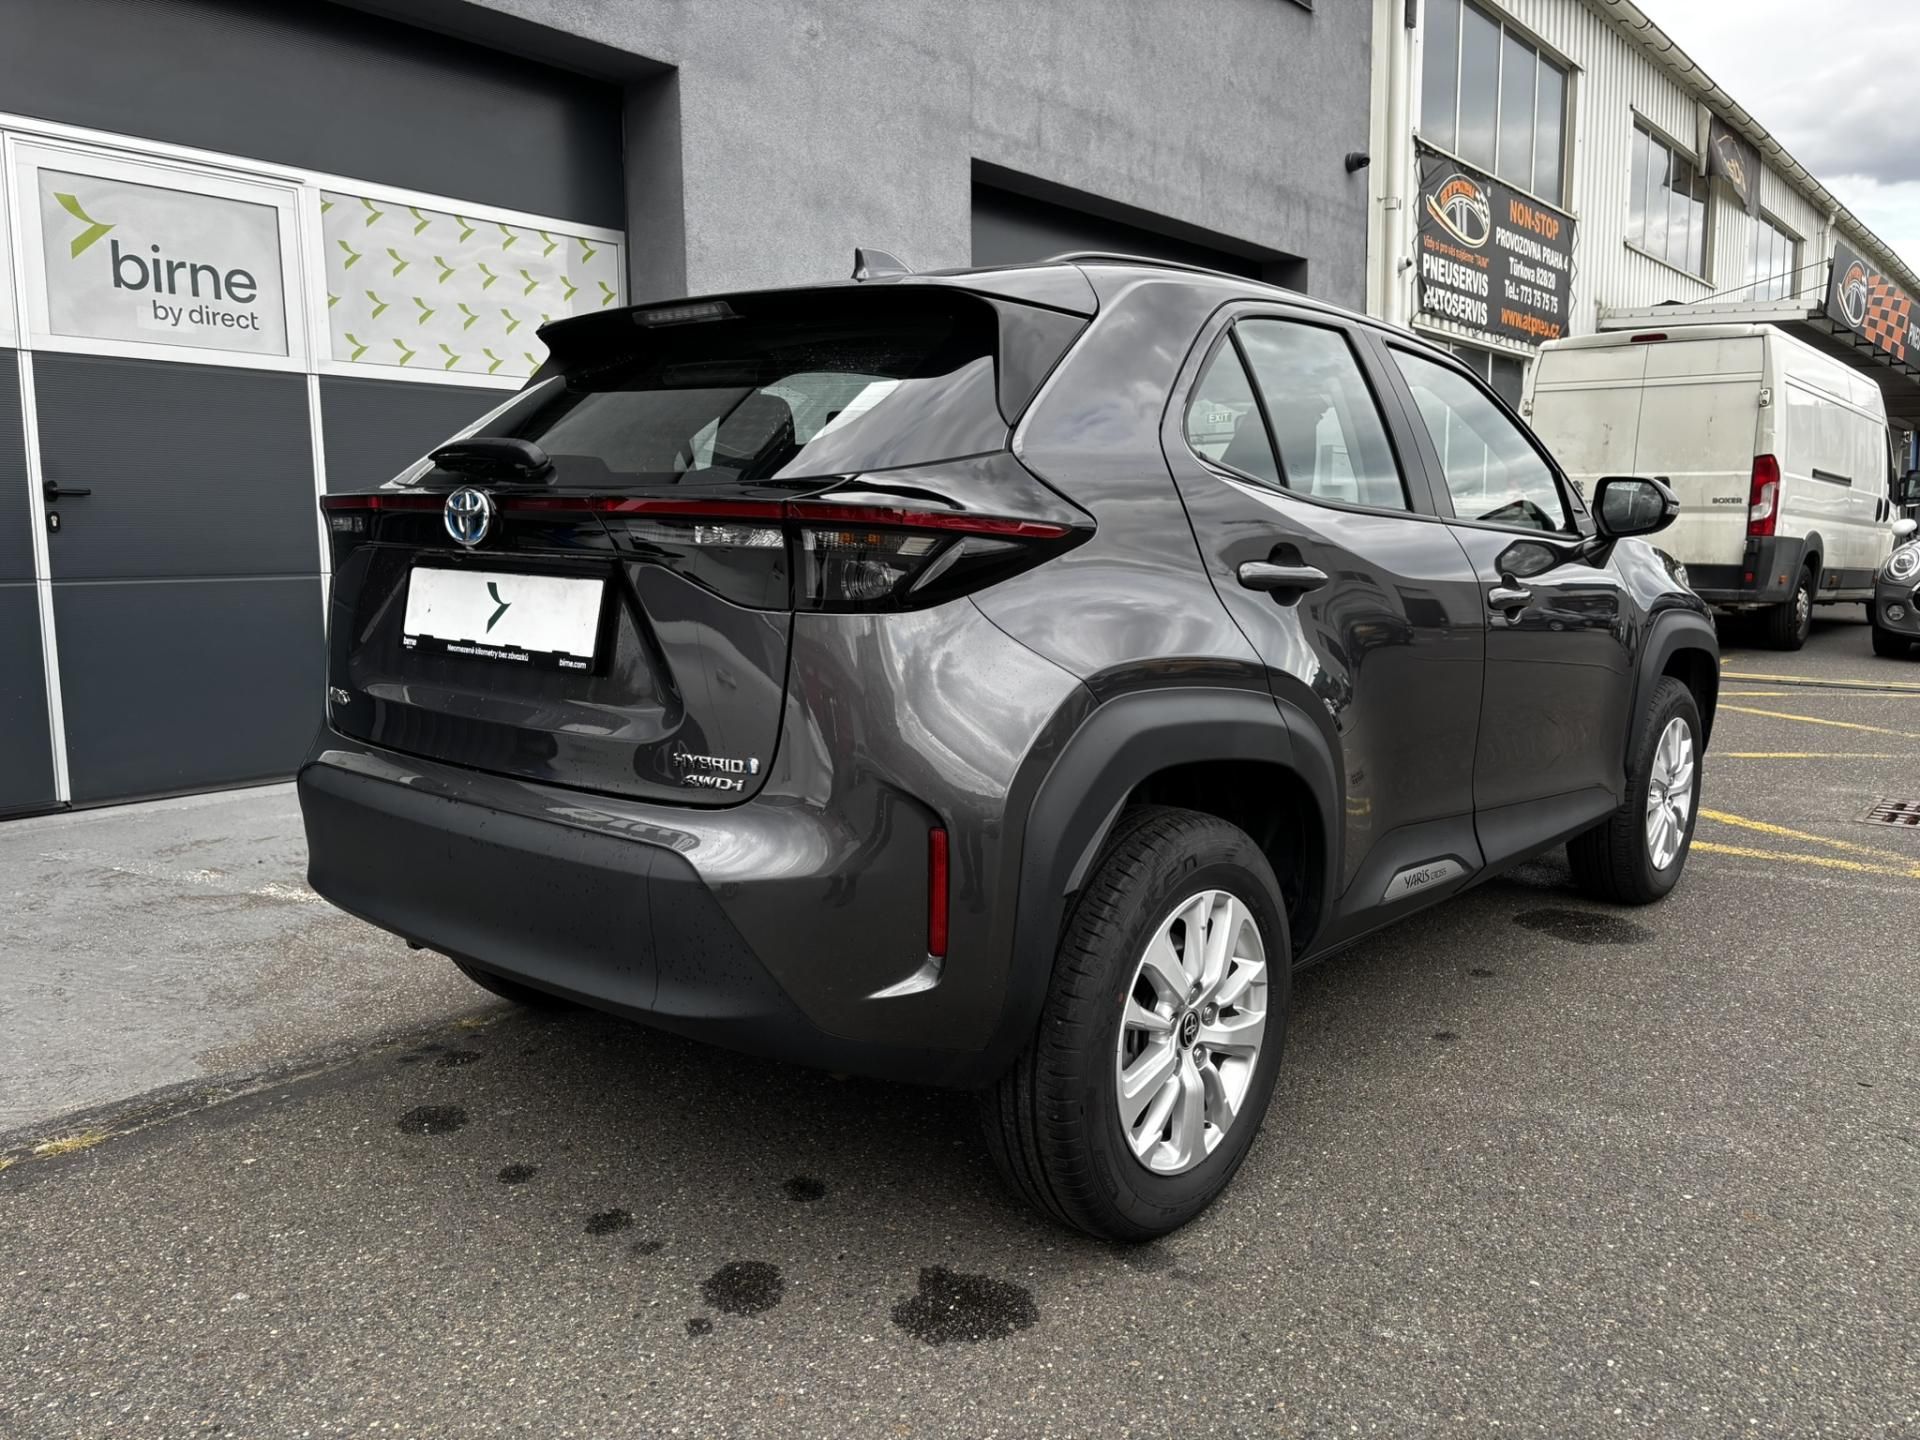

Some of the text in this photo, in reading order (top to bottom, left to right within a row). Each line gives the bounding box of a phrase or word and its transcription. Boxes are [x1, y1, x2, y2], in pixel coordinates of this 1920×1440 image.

[1510, 199, 1559, 240] NON-STOP
[1496, 226, 1541, 262] PROVOZOVNA
[1542, 246, 1563, 271] PRAHA
[1564, 256, 1569, 272] 4
[110, 239, 257, 304] birne
[1423, 253, 1489, 297] PNEUSERVIS
[1509, 256, 1535, 283] Türkova
[1423, 284, 1488, 326] AUTOSERVIS
[1504, 279, 1558, 314] Tel.: 773 75 75 75
[152, 299, 260, 331] by direct
[1501, 307, 1560, 338] www.atpneu.cz
[559, 658, 586, 669] birne.com
[673, 752, 745, 773] HYBRID
[1404, 869, 1430, 889] YARIS
